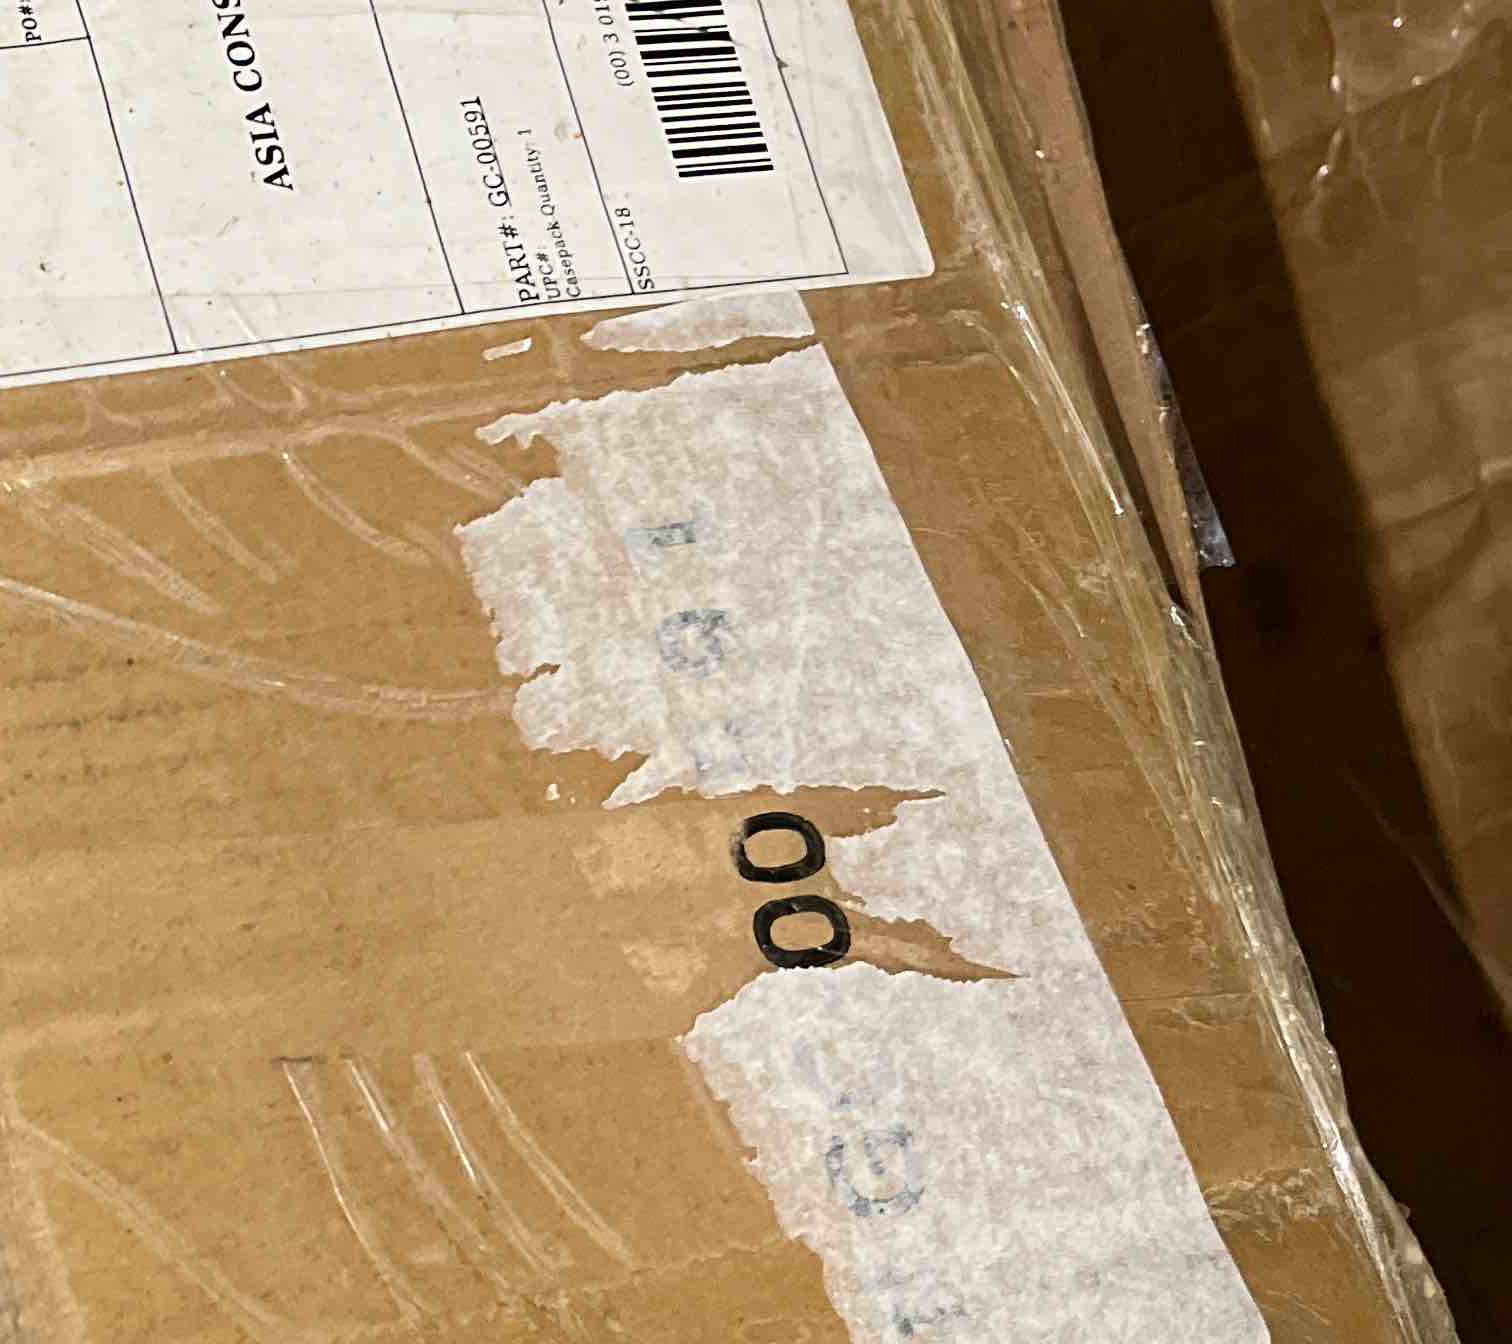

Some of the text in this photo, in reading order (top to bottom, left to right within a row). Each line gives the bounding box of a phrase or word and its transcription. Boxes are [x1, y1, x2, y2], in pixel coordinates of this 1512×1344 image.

[602, 32, 620, 44] 3
[610, 49, 636, 87] (00)
[244, 102, 294, 192] ASIA
[460, 96, 540, 302] PART#: GC-00591
[546, 221, 582, 298] Casepack
[614, 207, 656, 290] SSCC-18
